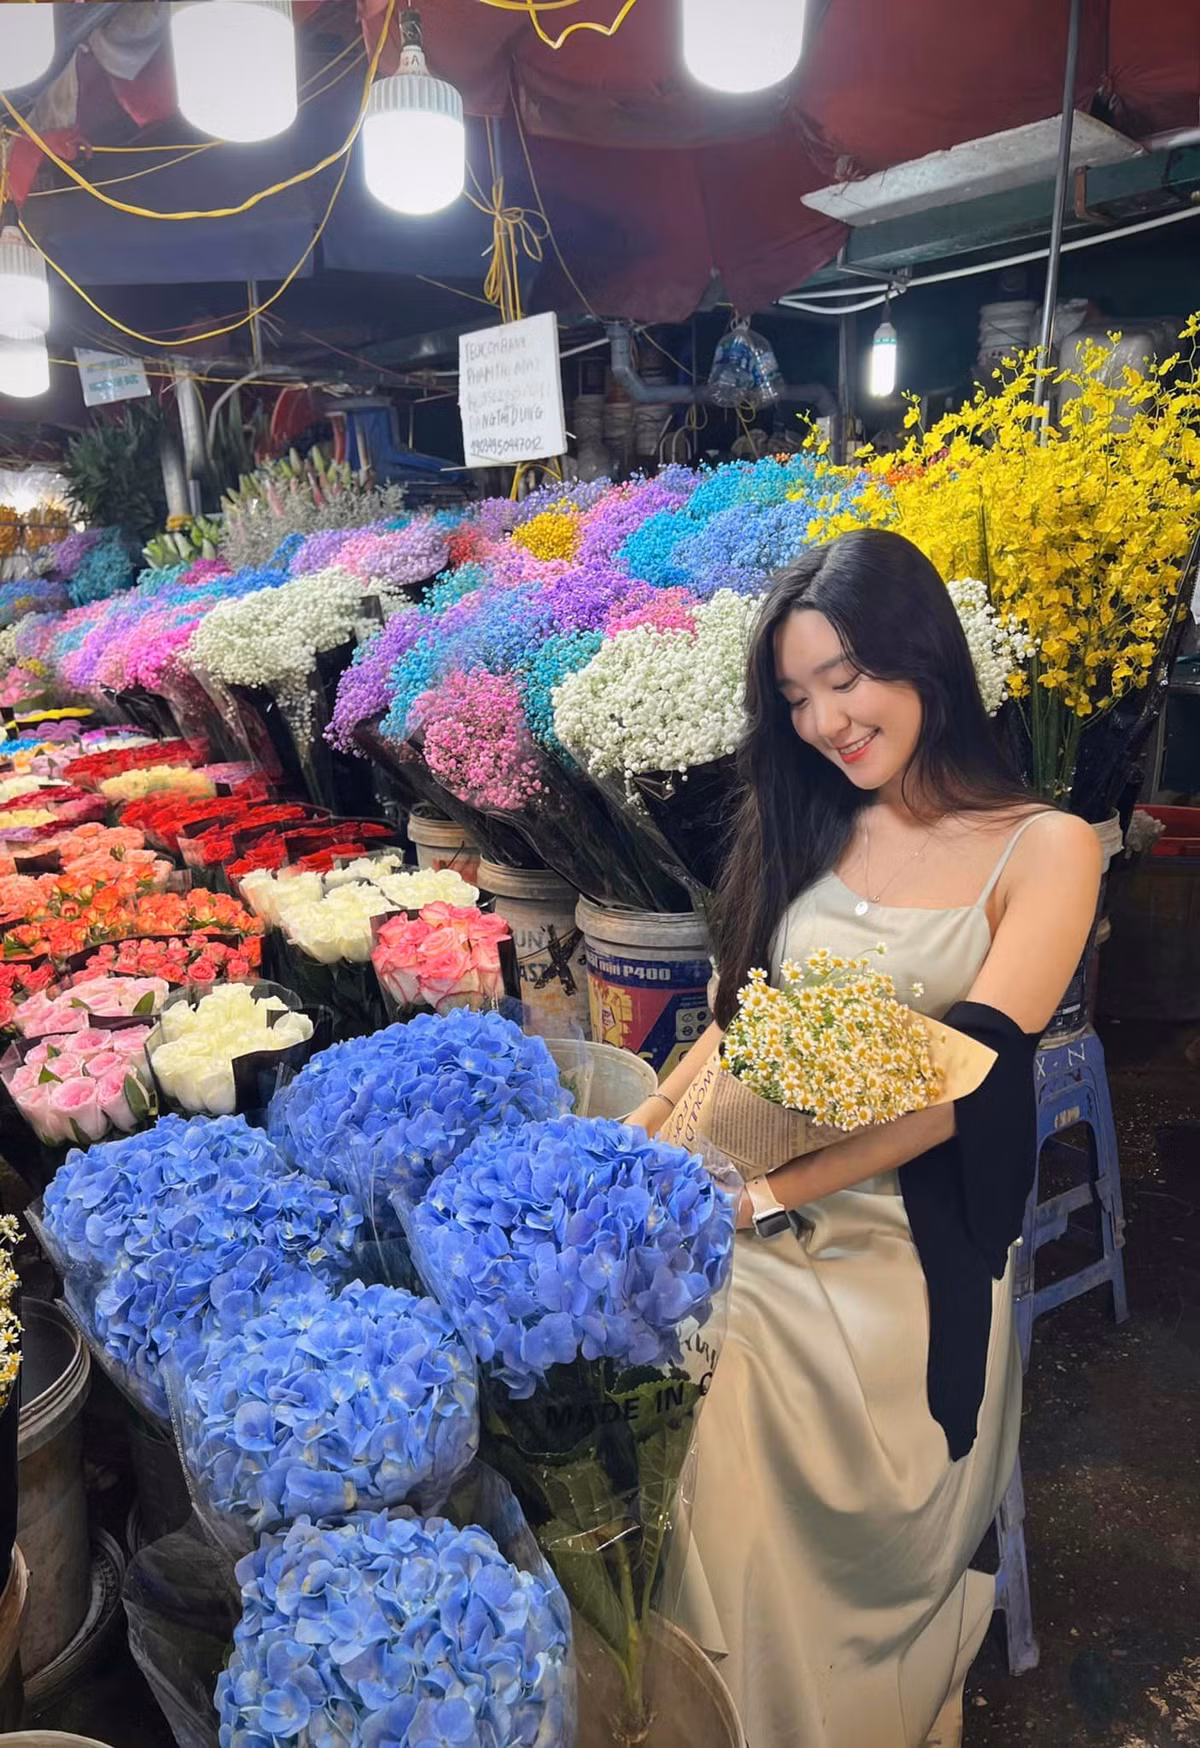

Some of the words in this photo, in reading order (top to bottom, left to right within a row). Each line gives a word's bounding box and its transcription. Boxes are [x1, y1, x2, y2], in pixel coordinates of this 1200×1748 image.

[623, 965, 671, 980] P400
[545, 1397, 640, 1428] MADE
[655, 1382, 684, 1414] IN
